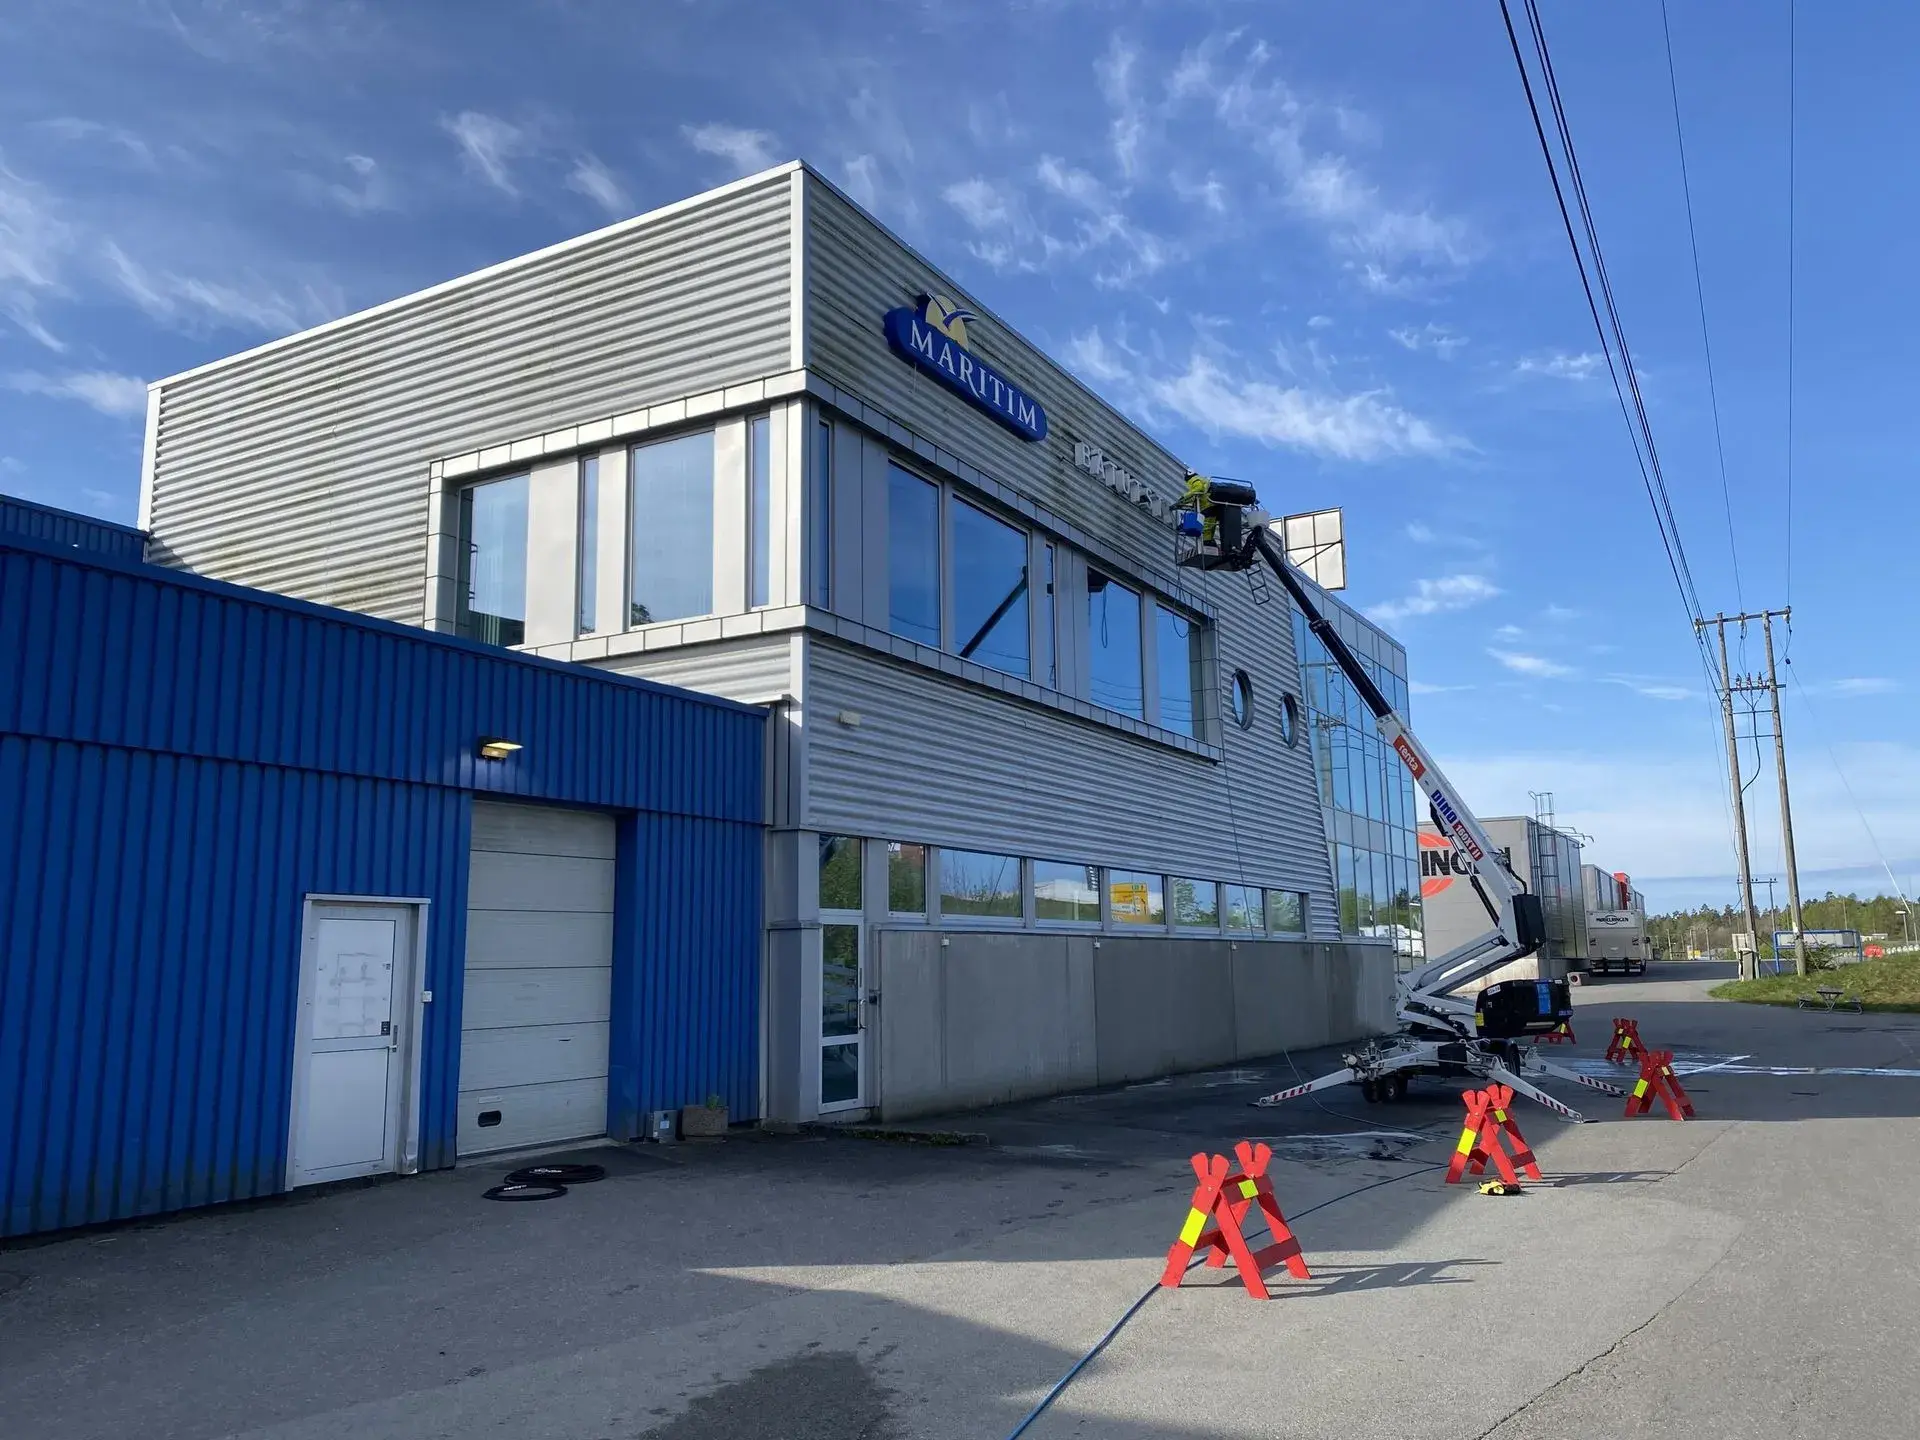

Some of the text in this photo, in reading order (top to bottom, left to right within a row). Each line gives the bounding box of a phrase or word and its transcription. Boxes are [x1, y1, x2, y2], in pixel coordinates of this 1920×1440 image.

[910, 319, 1038, 432] MARITIM
[1398, 744, 1419, 771] renta
[1430, 789, 1458, 824] DINO
